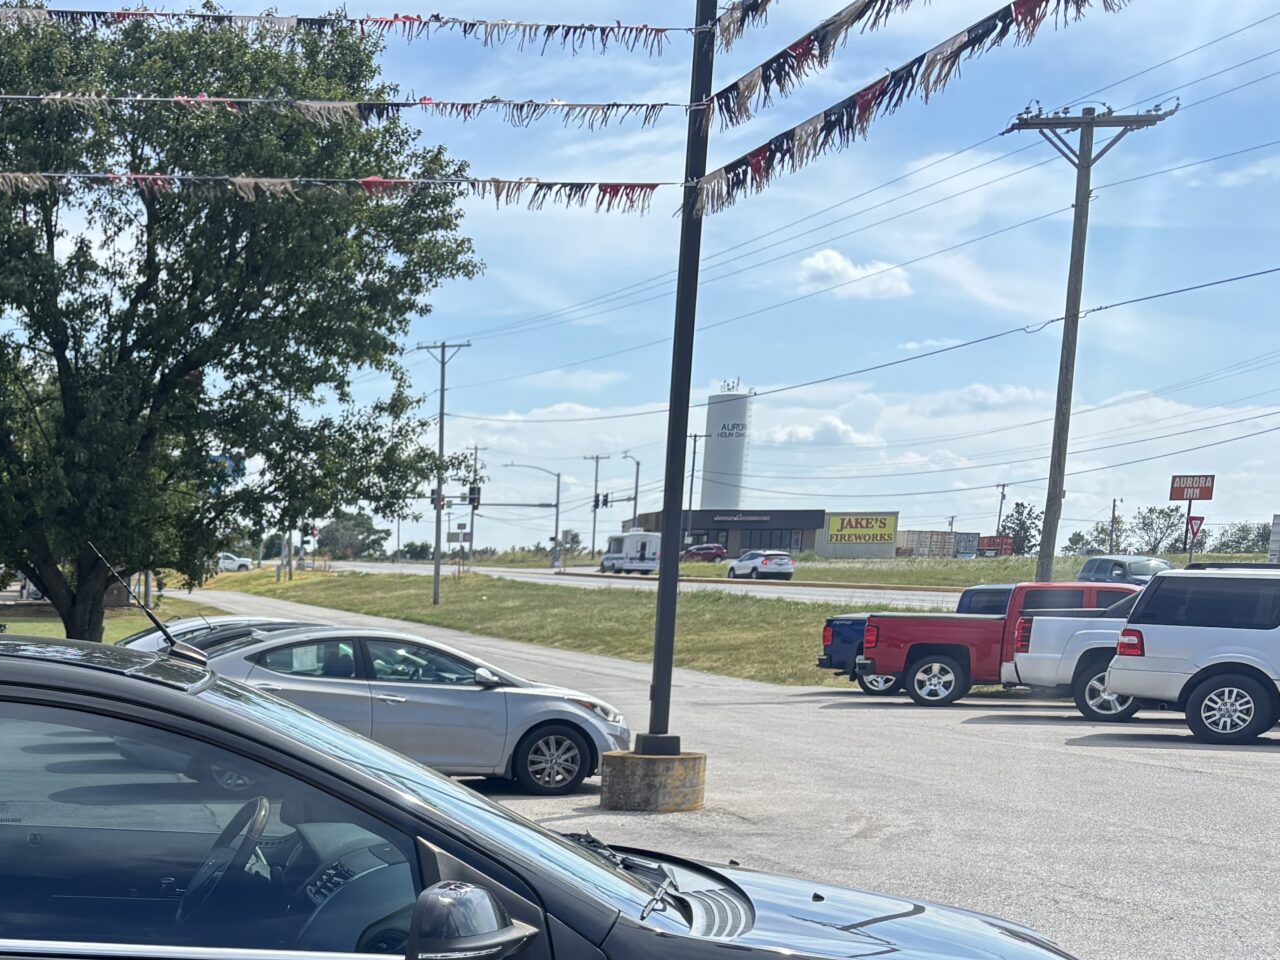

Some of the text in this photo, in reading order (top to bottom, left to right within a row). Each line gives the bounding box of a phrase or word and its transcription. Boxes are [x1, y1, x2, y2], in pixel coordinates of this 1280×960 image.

[1173, 477, 1212, 487] AURORA
[1184, 488, 1200, 498] INN
[837, 517, 887, 532] JAKE'S
[829, 533, 893, 542] FIREWORKS
